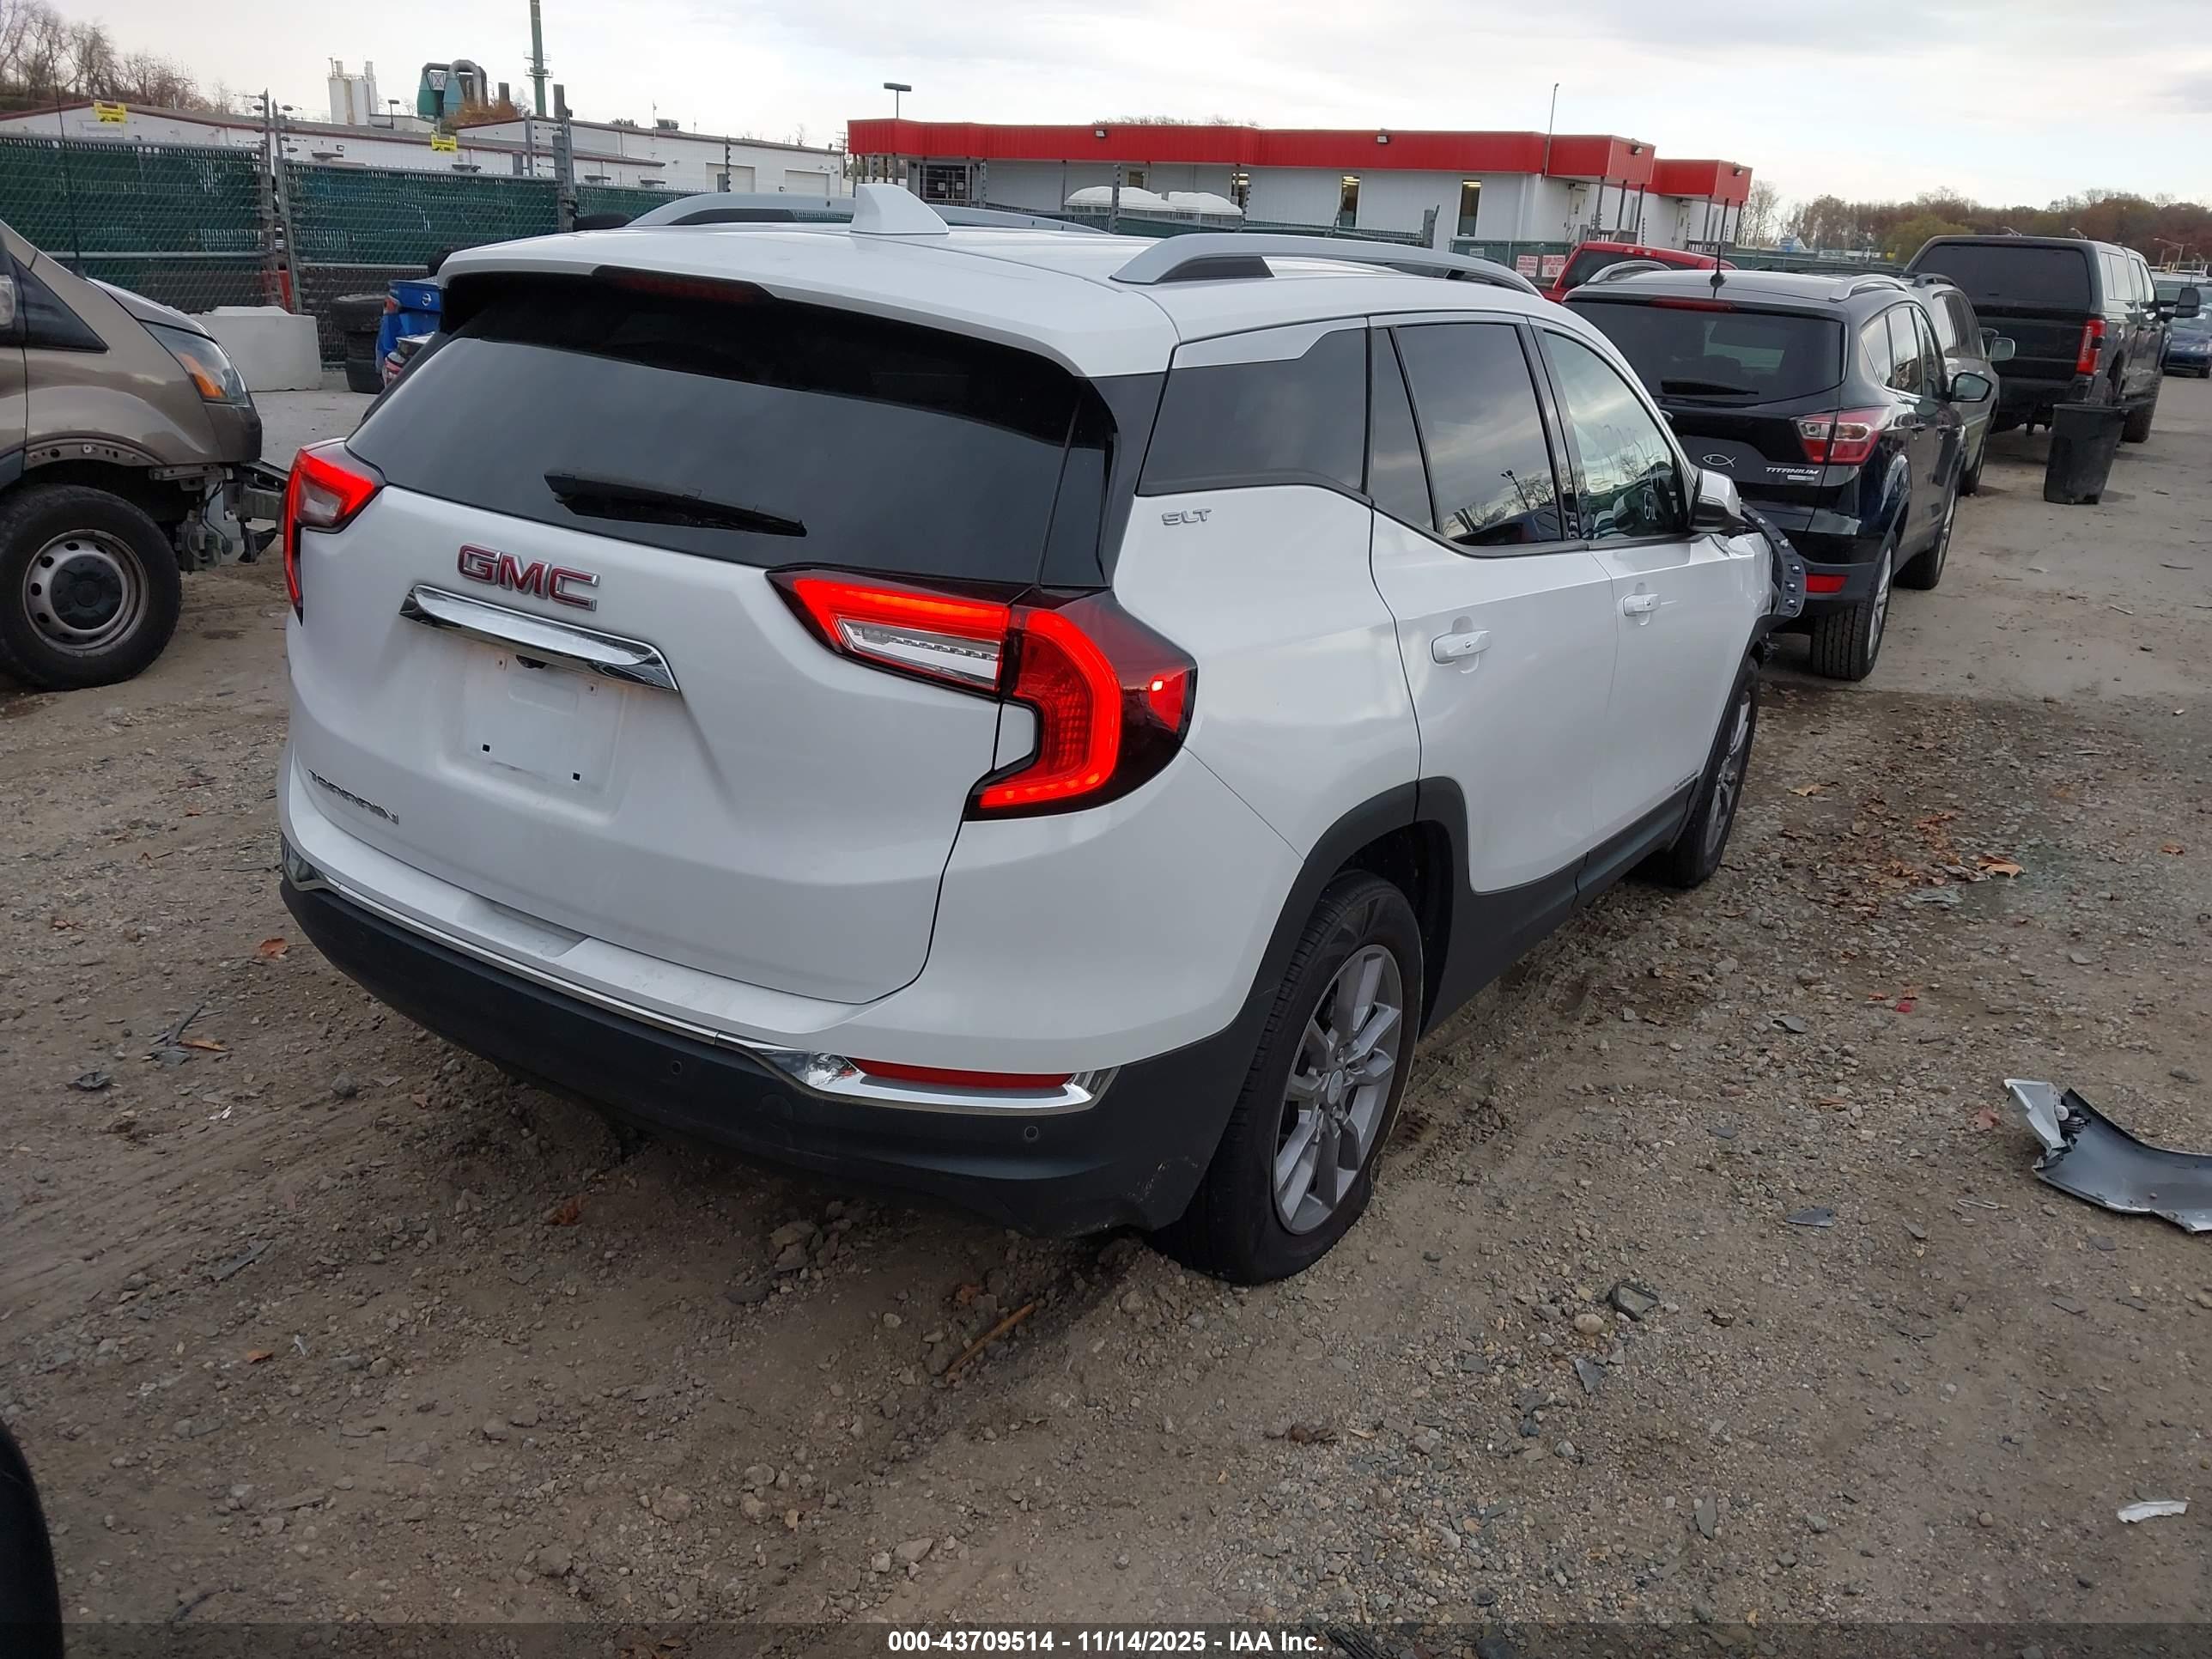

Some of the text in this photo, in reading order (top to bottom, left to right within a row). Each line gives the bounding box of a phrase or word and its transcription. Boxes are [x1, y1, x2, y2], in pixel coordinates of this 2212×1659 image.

[1765, 466, 1820, 475] TITANIUM
[1161, 508, 1212, 526] SLT
[457, 543, 600, 612] GMC
